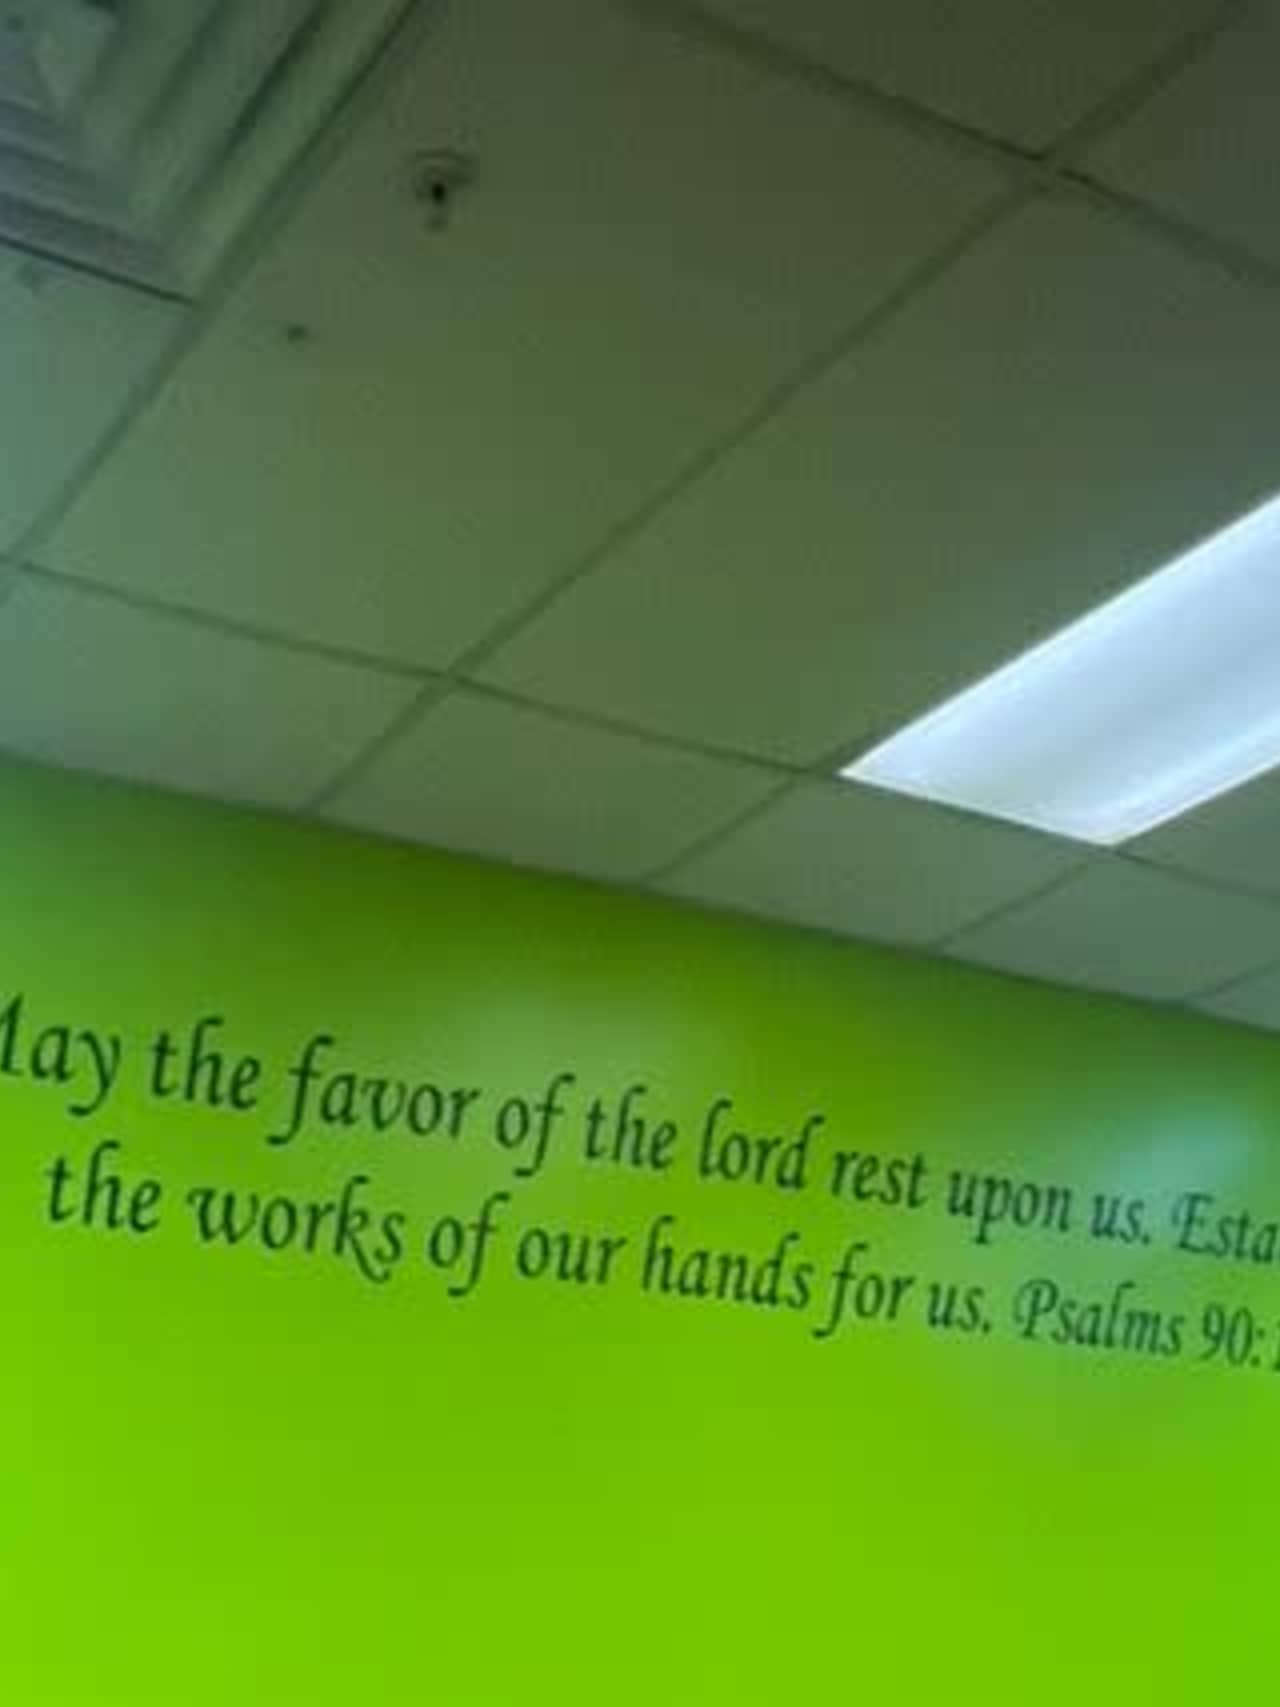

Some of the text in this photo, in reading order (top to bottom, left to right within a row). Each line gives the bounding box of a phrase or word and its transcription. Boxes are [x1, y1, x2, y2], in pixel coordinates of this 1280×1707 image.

[150, 1017, 260, 1110] the
[267, 1035, 480, 1147] favor
[496, 1073, 576, 1178] of
[585, 1085, 677, 1170] the
[699, 1099, 825, 1190] lord
[832, 1152, 927, 1209] rest
[946, 1170, 1072, 1246] upon
[1089, 1194, 1152, 1246] us.
[45, 1140, 162, 1233] the
[186, 1175, 405, 1283] works
[428, 1192, 510, 1298] of
[517, 1226, 627, 1285] our
[640, 1215, 814, 1310] hands
[812, 1243, 915, 1339] for
[926, 1281, 991, 1335] us.
[1014, 1278, 1185, 1357] Psalms
